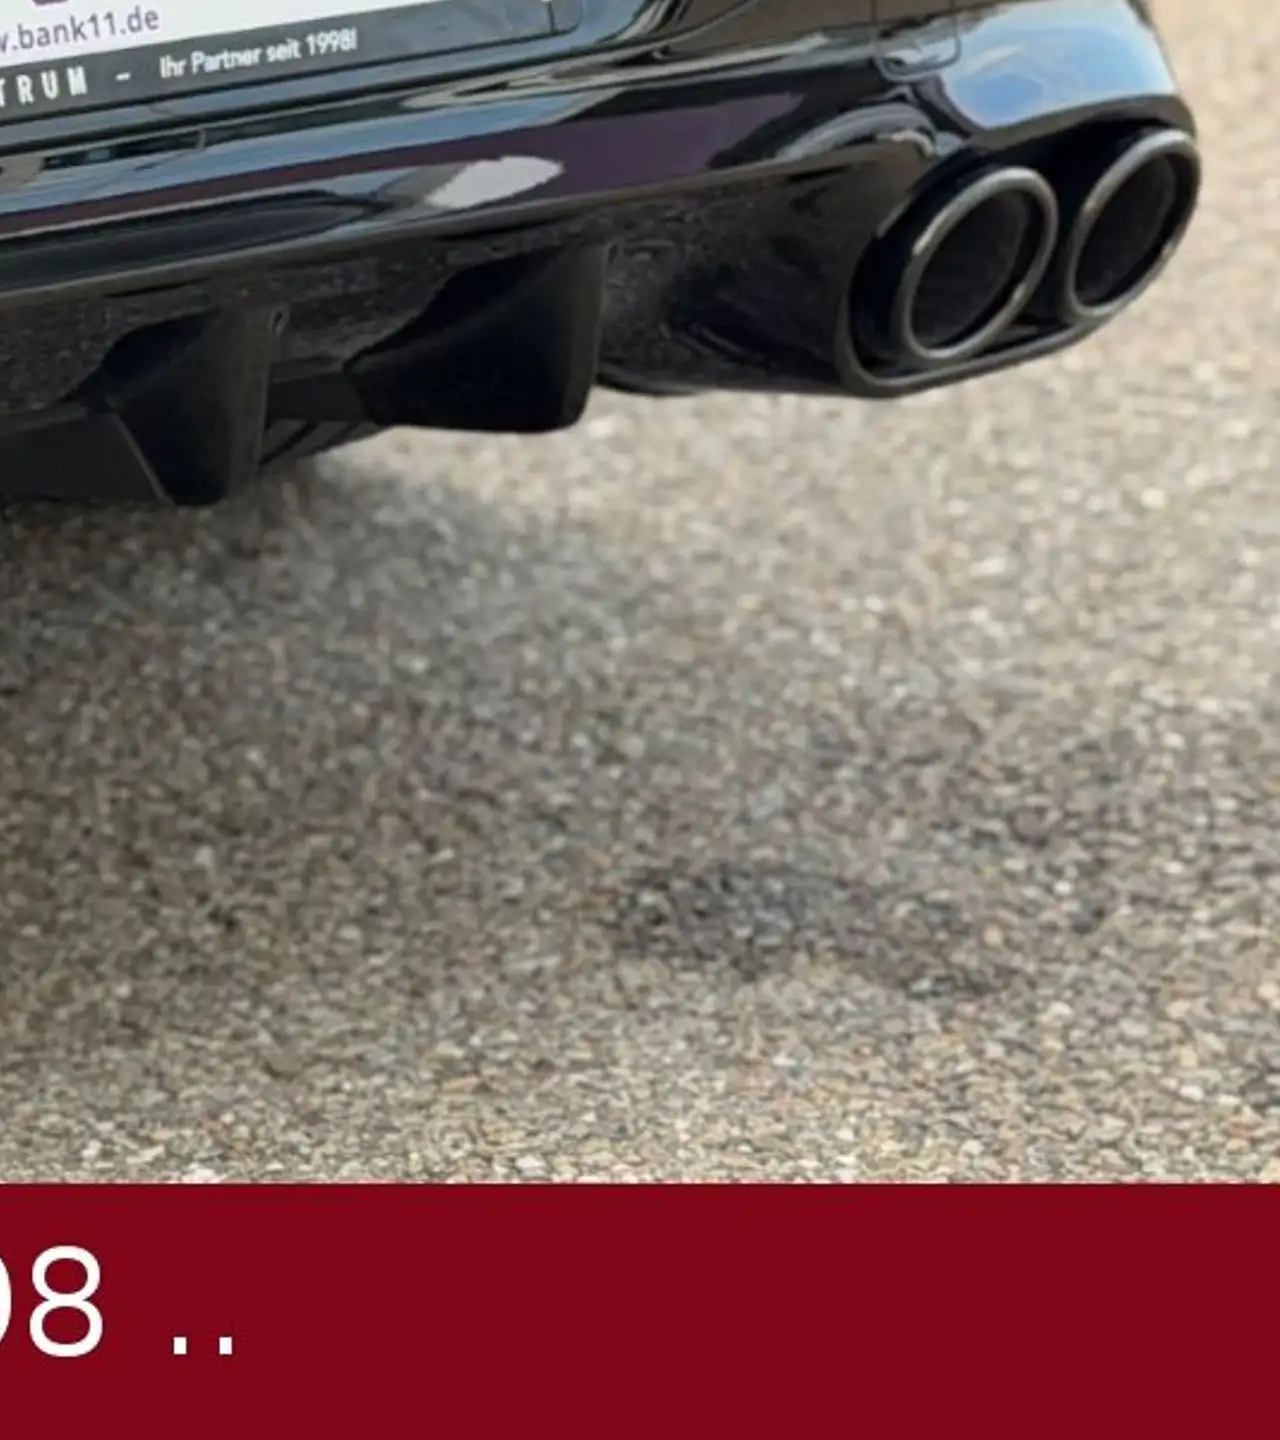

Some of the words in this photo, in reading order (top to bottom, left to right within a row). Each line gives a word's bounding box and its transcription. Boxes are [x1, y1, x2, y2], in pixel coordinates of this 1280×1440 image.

[159, 54, 188, 79] Ihr
[191, 47, 263, 76] Partner
[266, 37, 301, 63] seit
